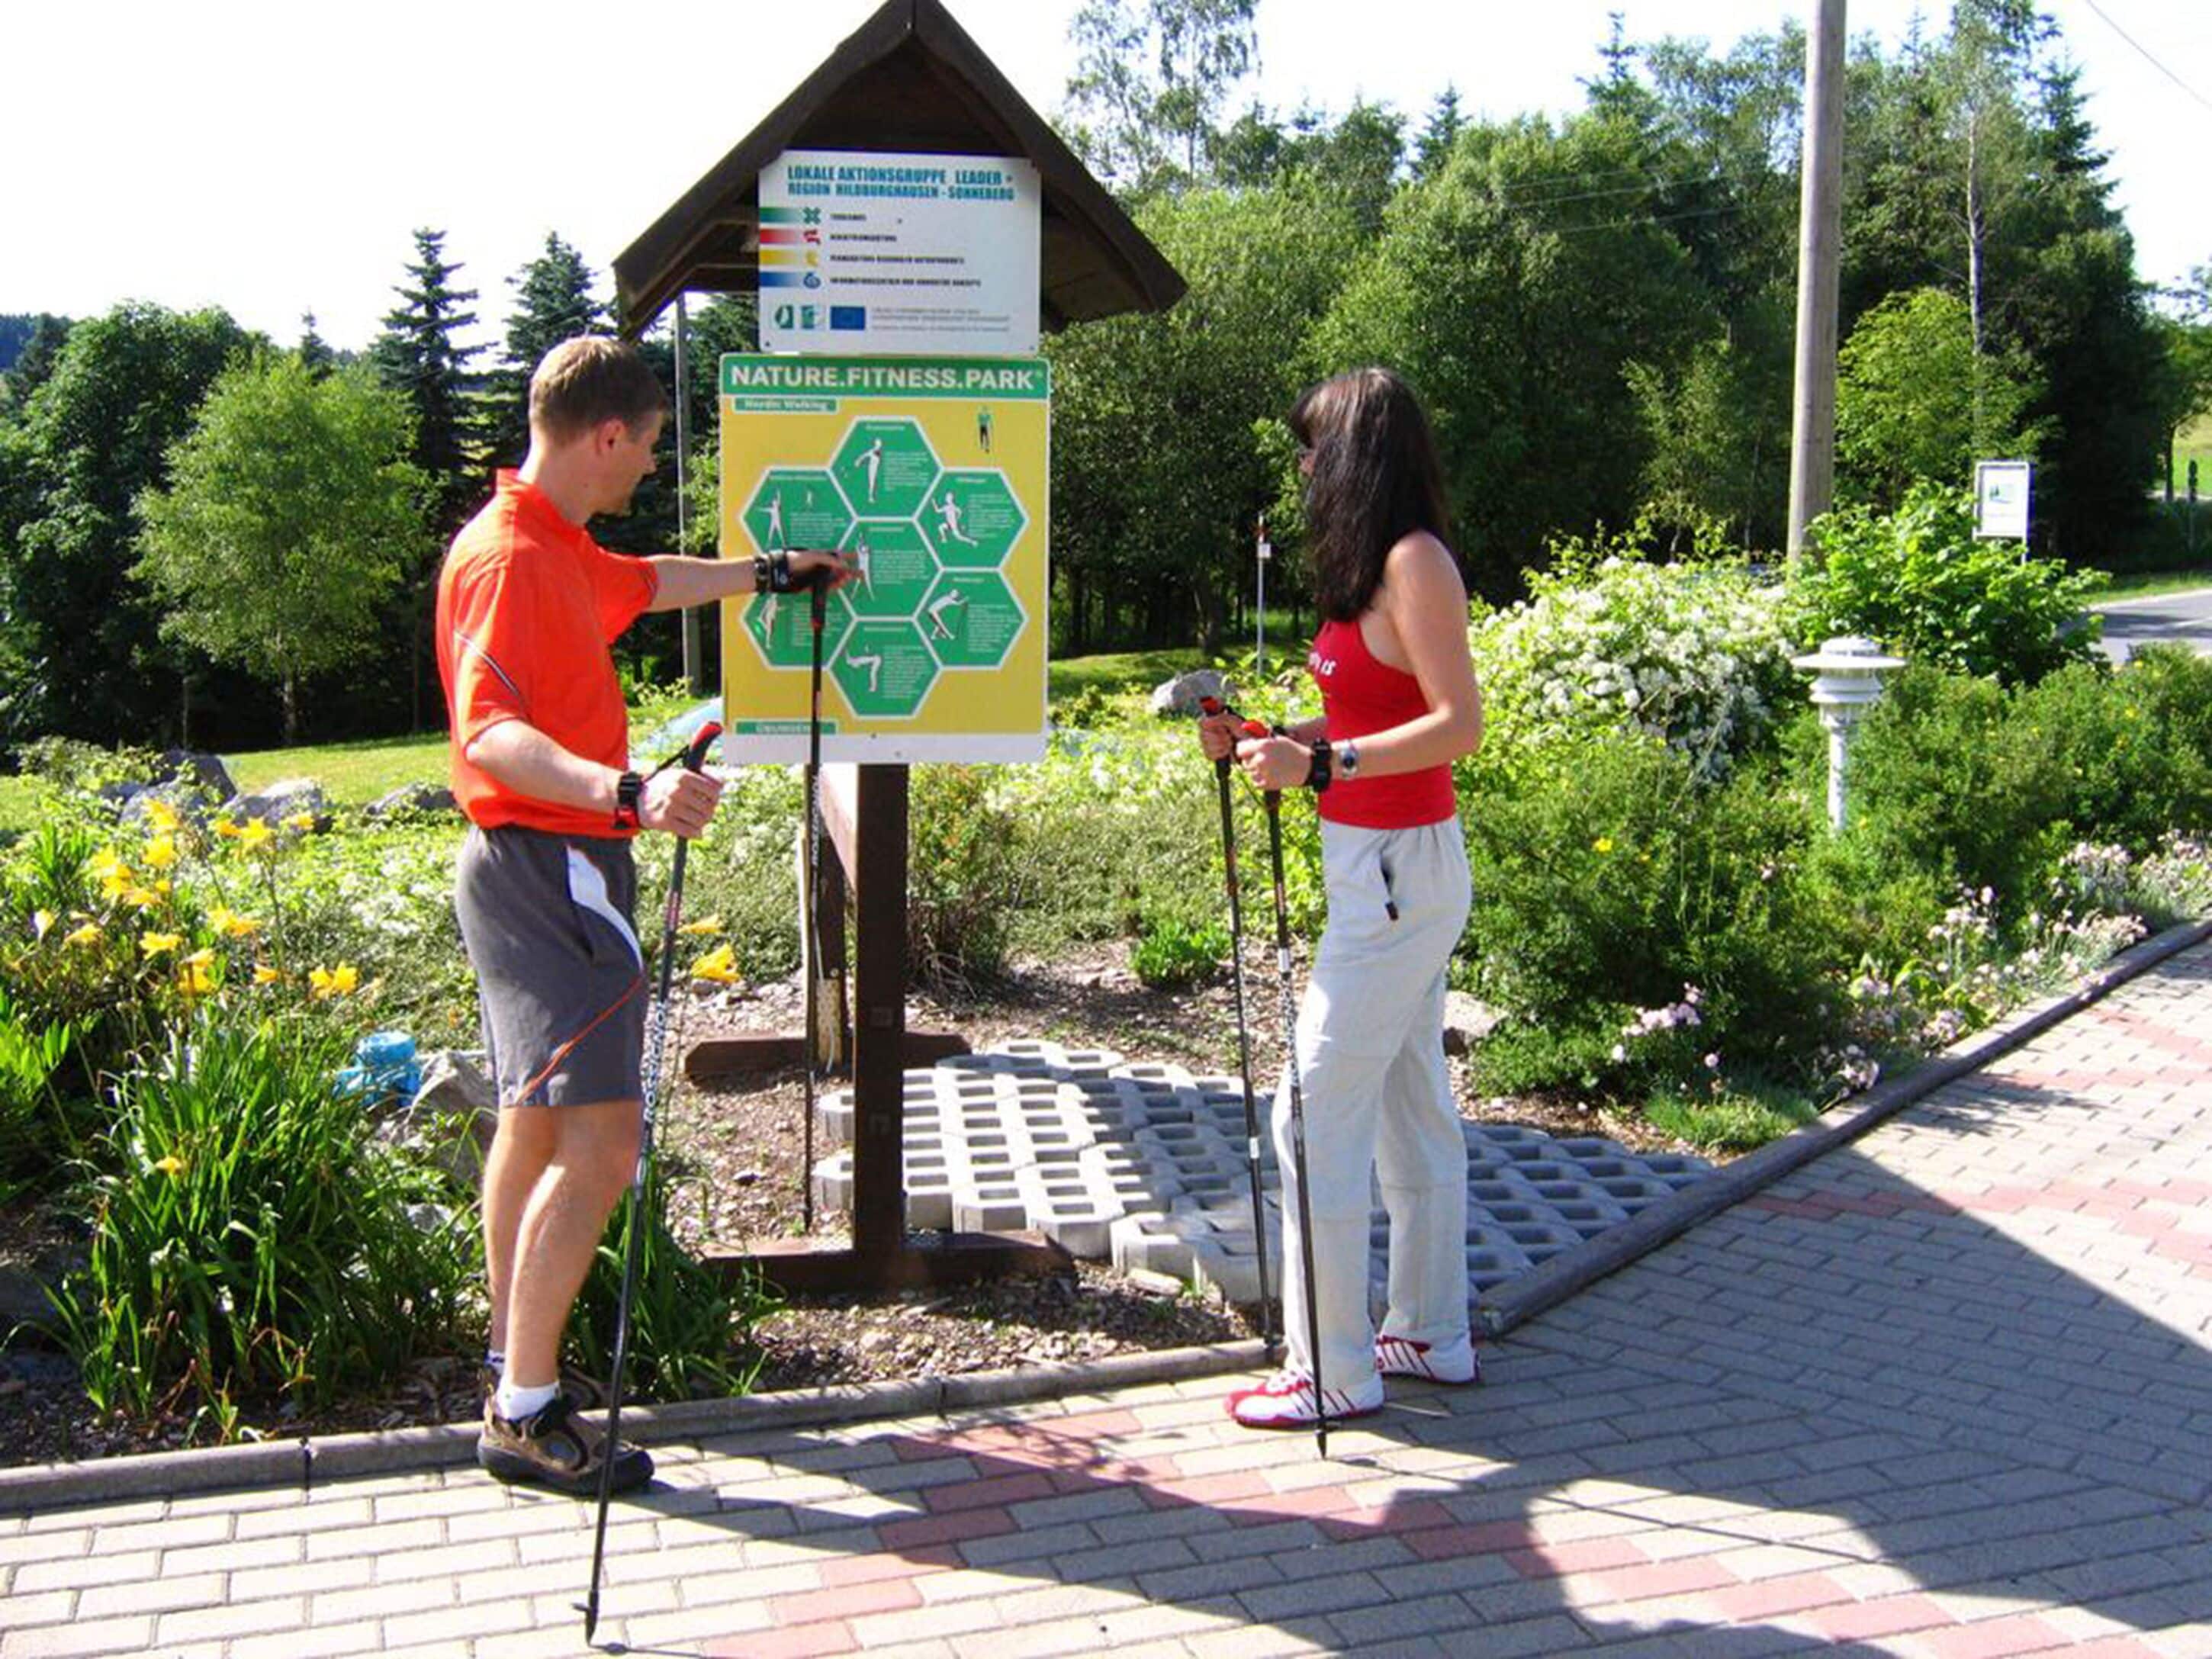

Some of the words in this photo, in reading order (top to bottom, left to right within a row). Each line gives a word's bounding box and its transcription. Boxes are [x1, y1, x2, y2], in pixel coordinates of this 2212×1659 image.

[788, 166, 834, 180] LOKALE
[838, 166, 946, 184] AKTIONSGRUPPE
[955, 170, 1002, 184] LEADER
[788, 182, 830, 195] REGION
[835, 184, 938, 198] HILDBURGHAUSEN
[948, 187, 1014, 200] SONNEBERG
